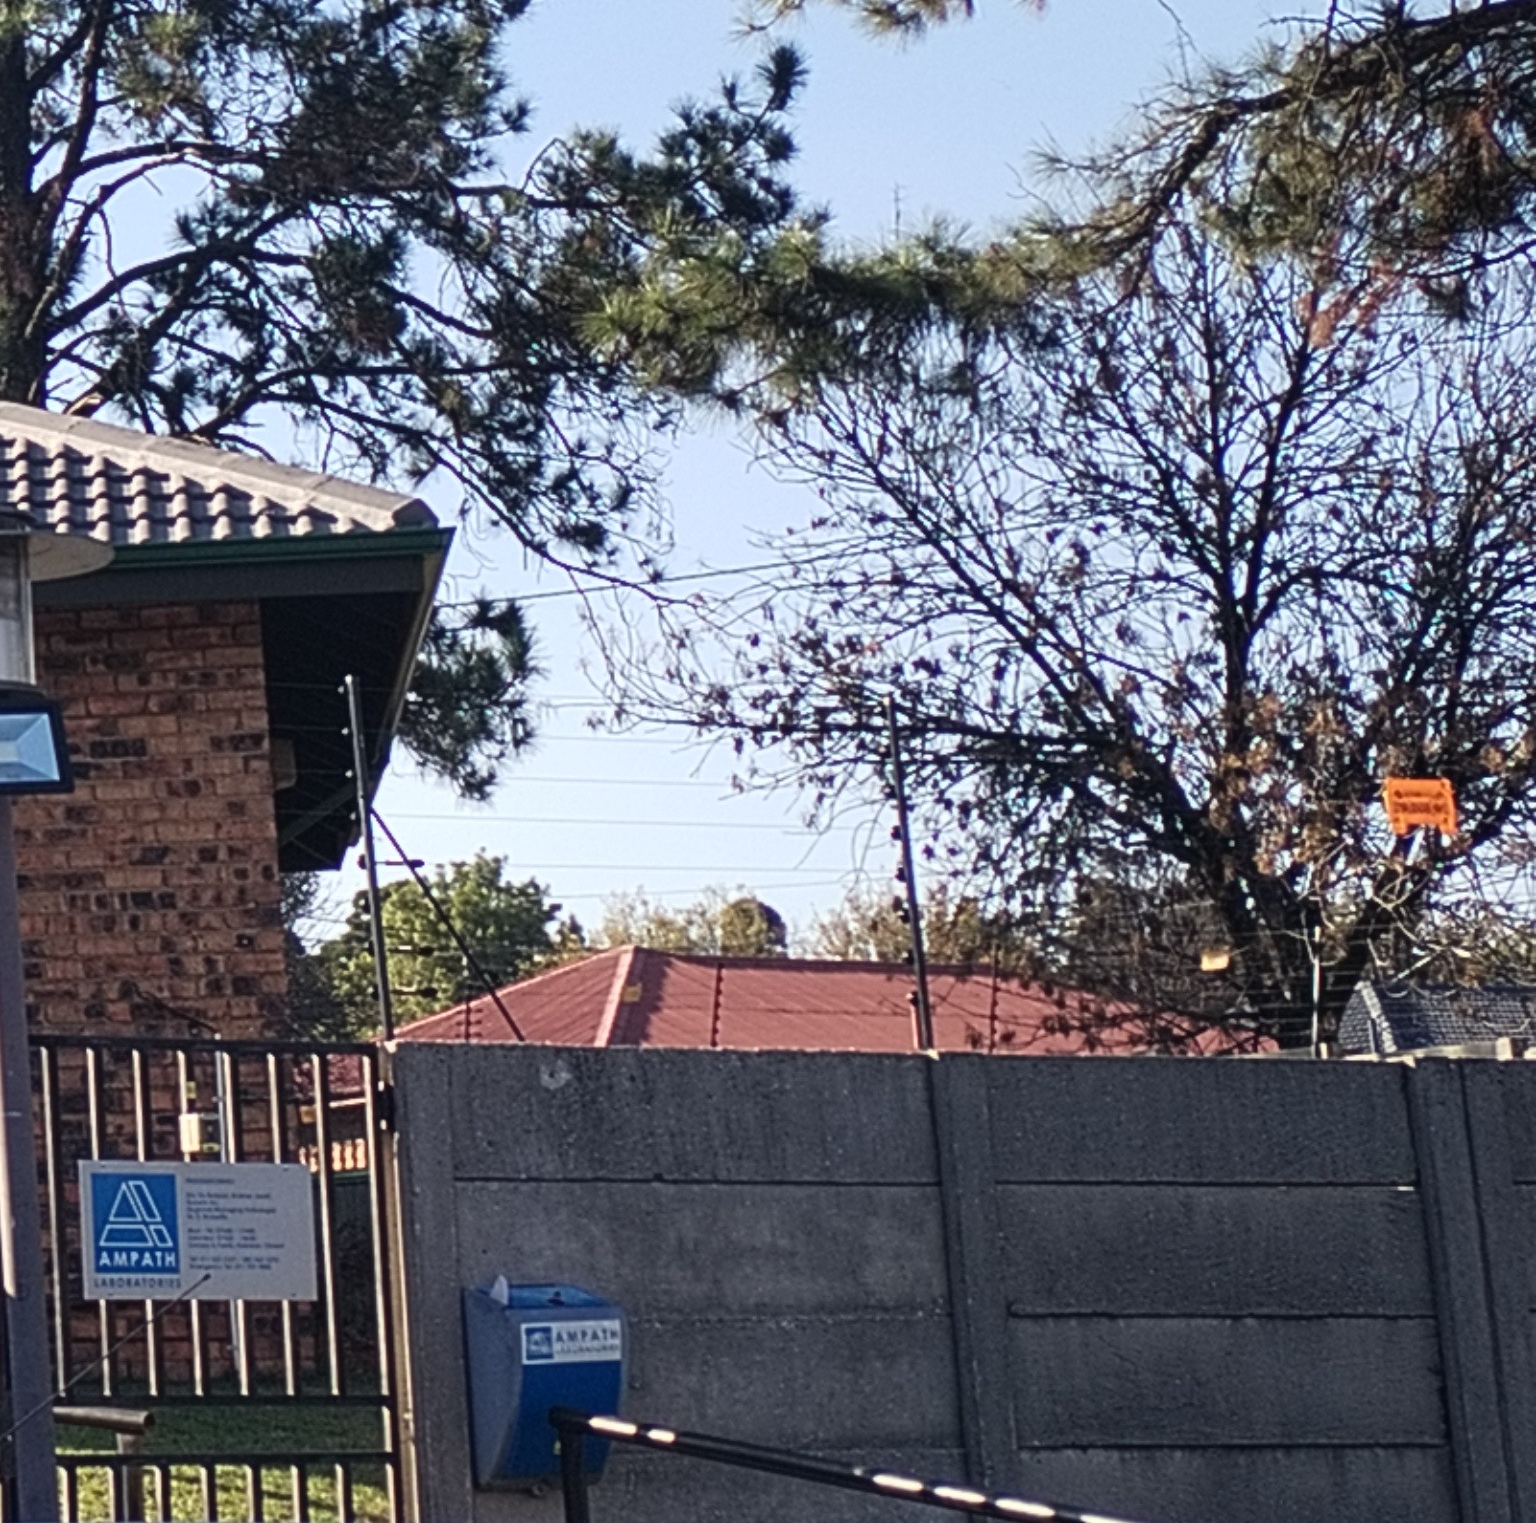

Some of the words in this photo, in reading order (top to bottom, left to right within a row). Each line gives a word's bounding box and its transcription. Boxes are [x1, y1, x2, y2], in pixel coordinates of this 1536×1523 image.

[99, 1250, 176, 1267] AMPATH
[94, 1277, 181, 1289] LABORATORIES
[555, 1328, 618, 1342] AMPATH
